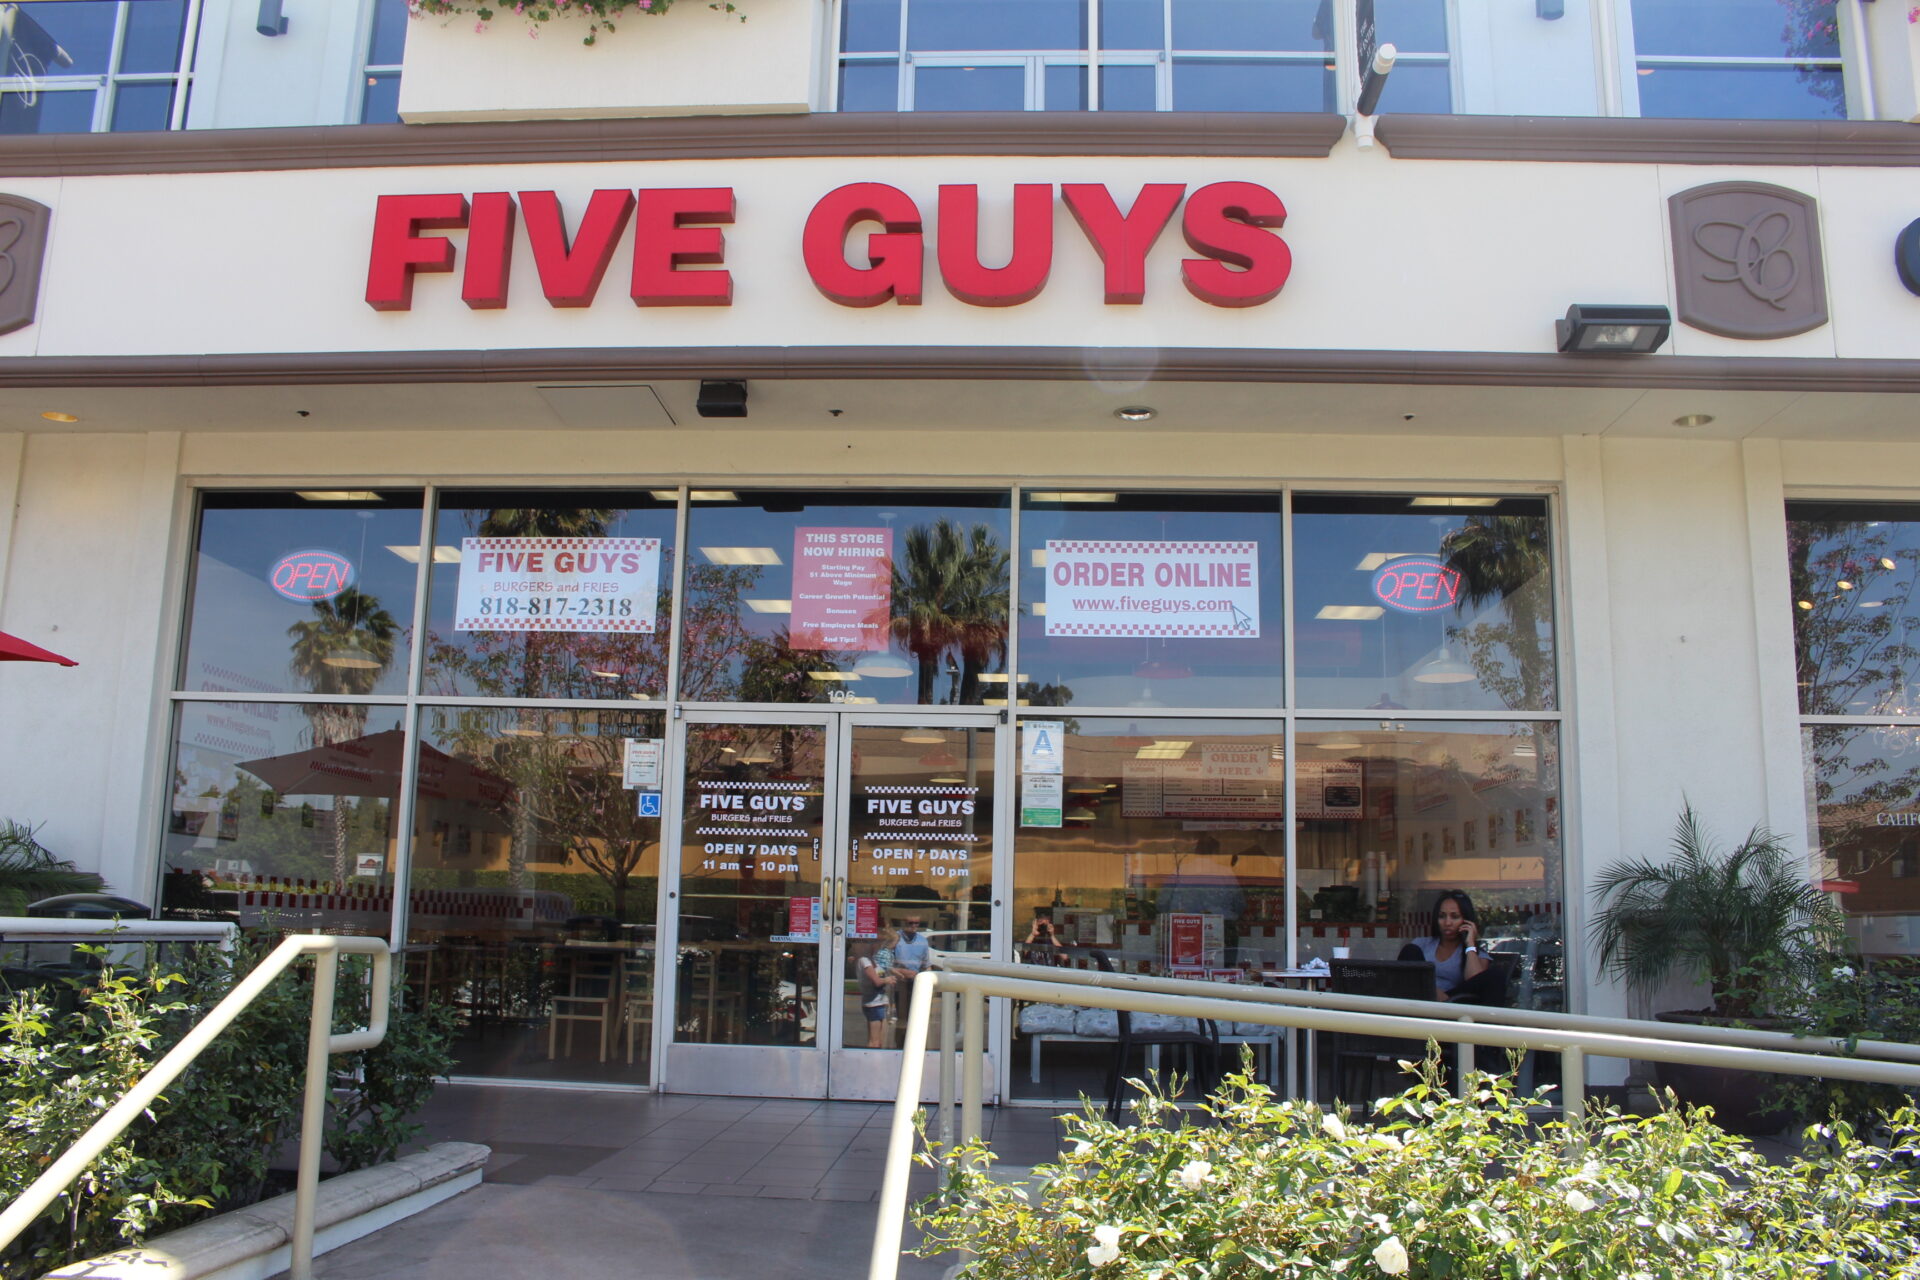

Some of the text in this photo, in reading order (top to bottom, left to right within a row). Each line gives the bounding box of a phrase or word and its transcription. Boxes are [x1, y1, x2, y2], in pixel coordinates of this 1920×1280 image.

[365, 181, 1293, 311] FIVE GUYS
[806, 533, 884, 544] THIS STORE
[803, 547, 885, 557] NOW HIRING
[477, 552, 640, 574] FIVE GUYS
[273, 563, 351, 589] OPEN
[1053, 561, 1252, 588] ORDER ONLINE
[493, 581, 619, 593] BURGERS and FRIES
[1376, 572, 1461, 600] OPEN
[479, 597, 632, 617] 818-817-2318
[1072, 596, 1233, 613] www.fiveguys.com
[828, 690, 856, 703] 106
[1032, 729, 1053, 755] A
[1211, 753, 1258, 763] ORDER
[1218, 767, 1252, 776] HERE
[700, 794, 806, 811] FIVE GUYS
[867, 799, 975, 815] FIVE GUYS
[711, 814, 751, 822] BURGERS
[769, 815, 793, 823] FRIES
[704, 843, 798, 856] OPEN 7 DAYS
[873, 848, 968, 860] OPEN 7 DAYS
[703, 860, 715, 869] 11
[720, 862, 740, 870] am
[760, 861, 775, 871] 10
[778, 864, 799, 873] pm
[872, 865, 884, 875] 11
[889, 867, 909, 875] am
[930, 866, 945, 876] 10
[949, 868, 969, 877] pm
